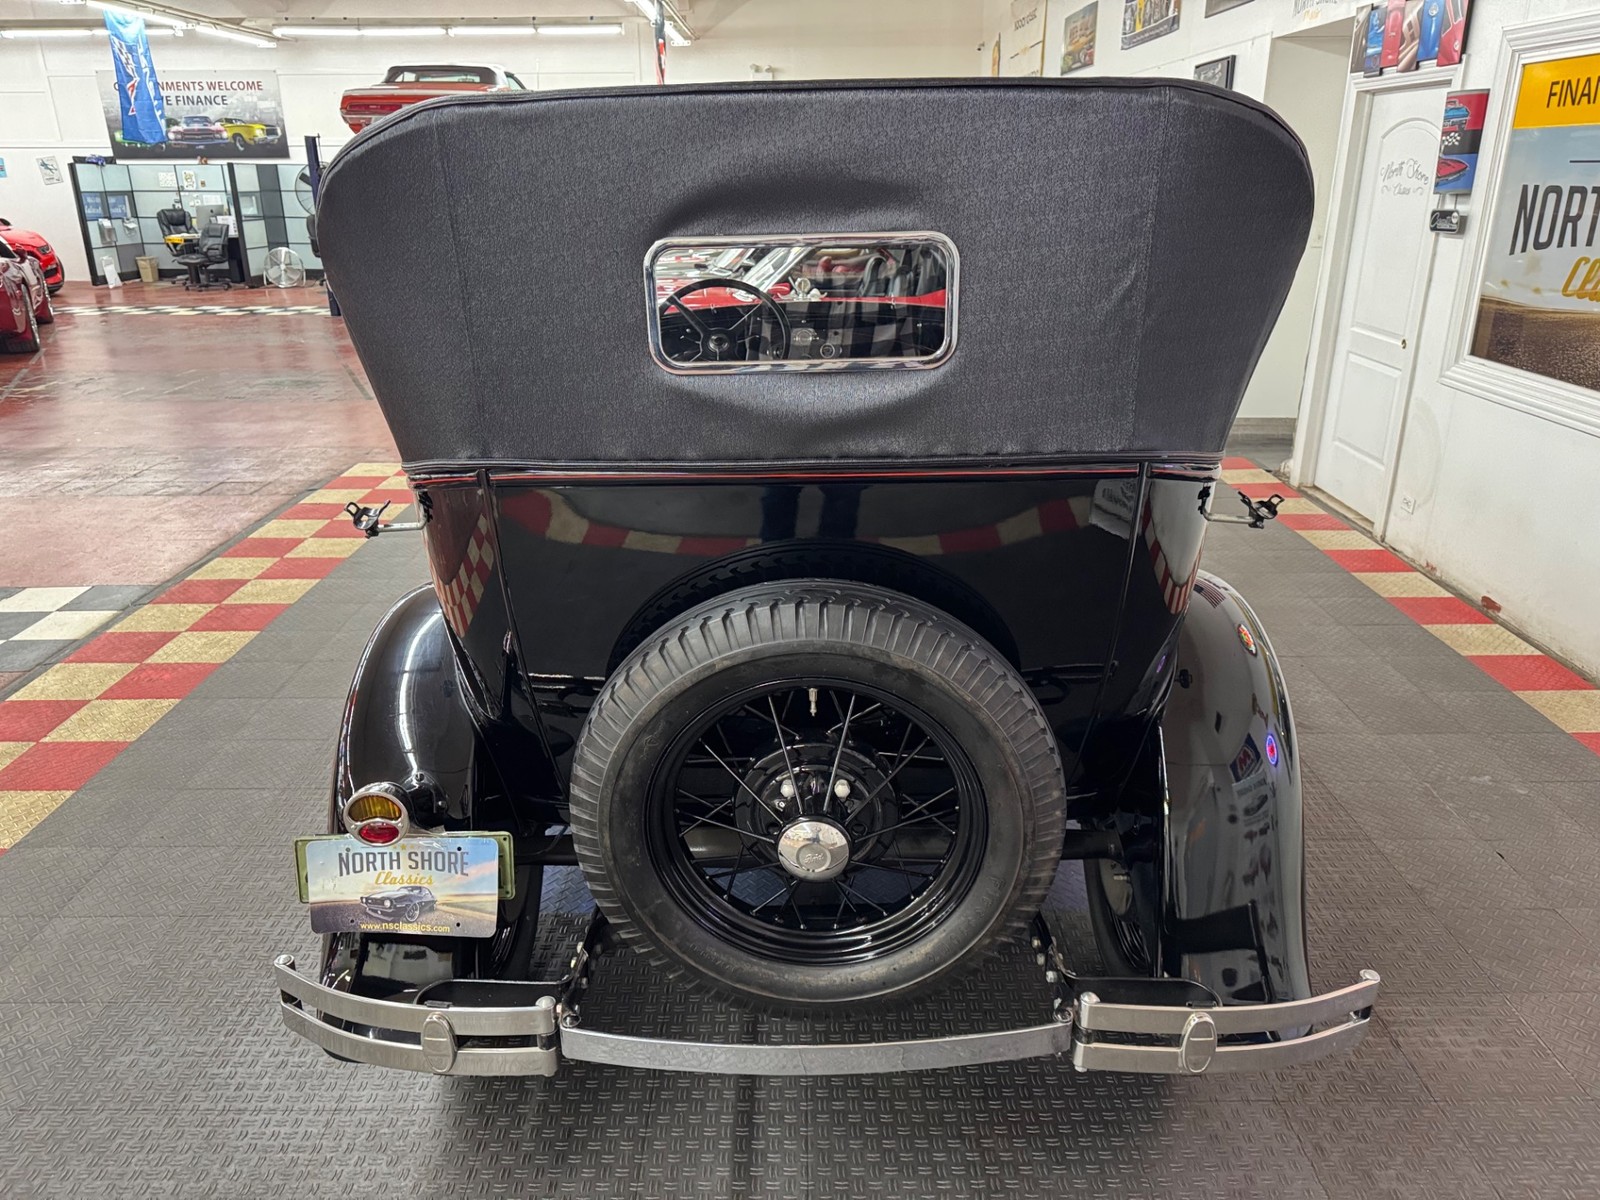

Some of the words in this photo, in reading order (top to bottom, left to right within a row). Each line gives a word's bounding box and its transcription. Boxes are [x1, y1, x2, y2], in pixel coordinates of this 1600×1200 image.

[206, 81, 264, 92] WELCOME
[1546, 75, 1600, 109] FINA
[174, 95, 229, 106] FINANCE
[1508, 183, 1600, 256] NORT
[338, 851, 401, 877] NORTH
[407, 851, 470, 877] SHORE
[374, 871, 434, 885] Classics
[360, 921, 450, 933] www.nsclassics.com
